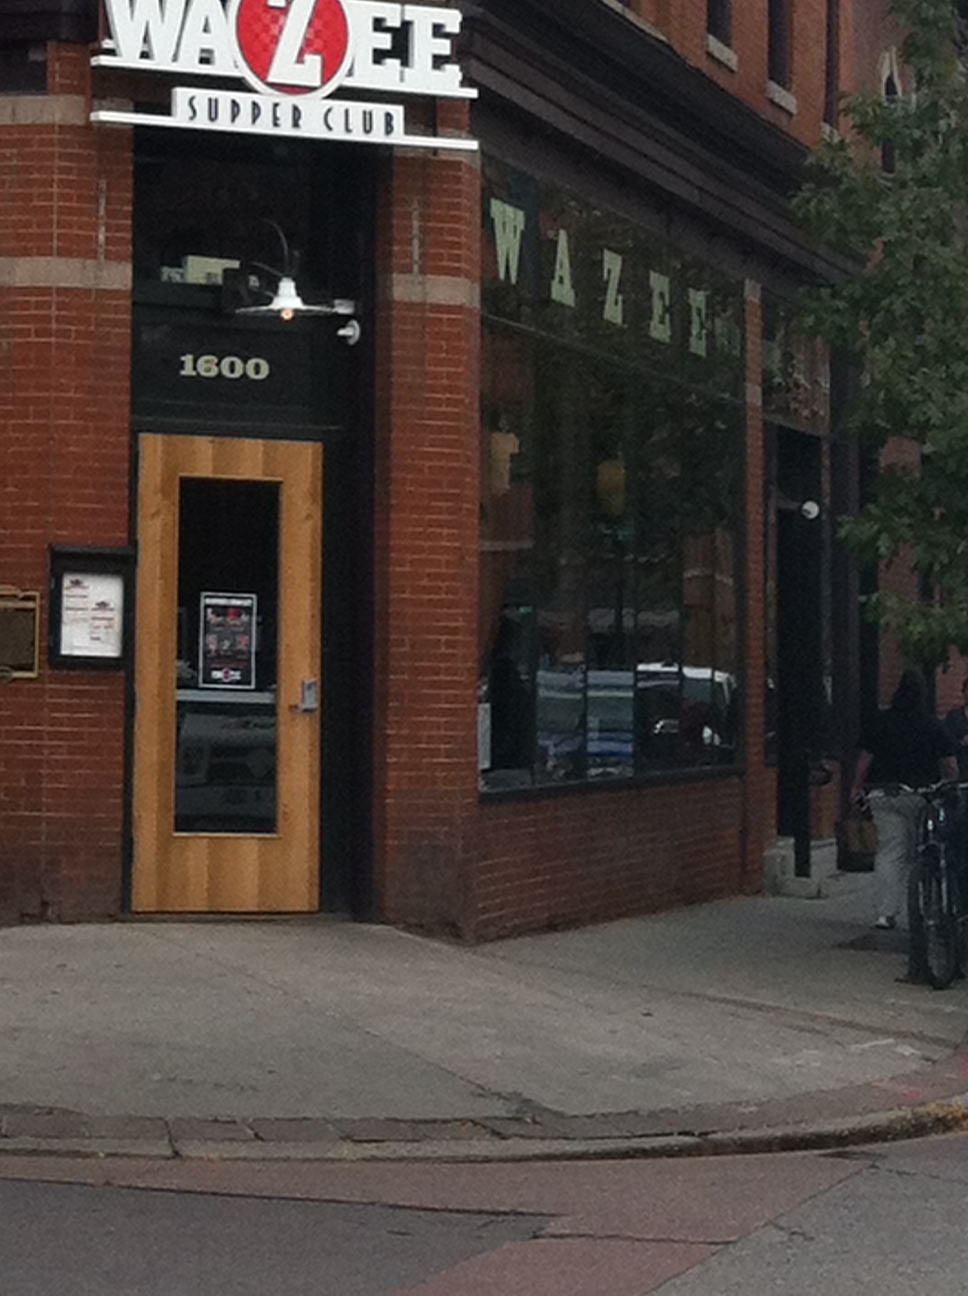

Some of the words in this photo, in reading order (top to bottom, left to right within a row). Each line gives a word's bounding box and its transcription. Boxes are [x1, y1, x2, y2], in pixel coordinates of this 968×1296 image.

[188, 95, 302, 129] SUPPER
[323, 106, 395, 136] CLUB
[489, 197, 709, 358] WAZEE
[180, 354, 270, 381] 1600
